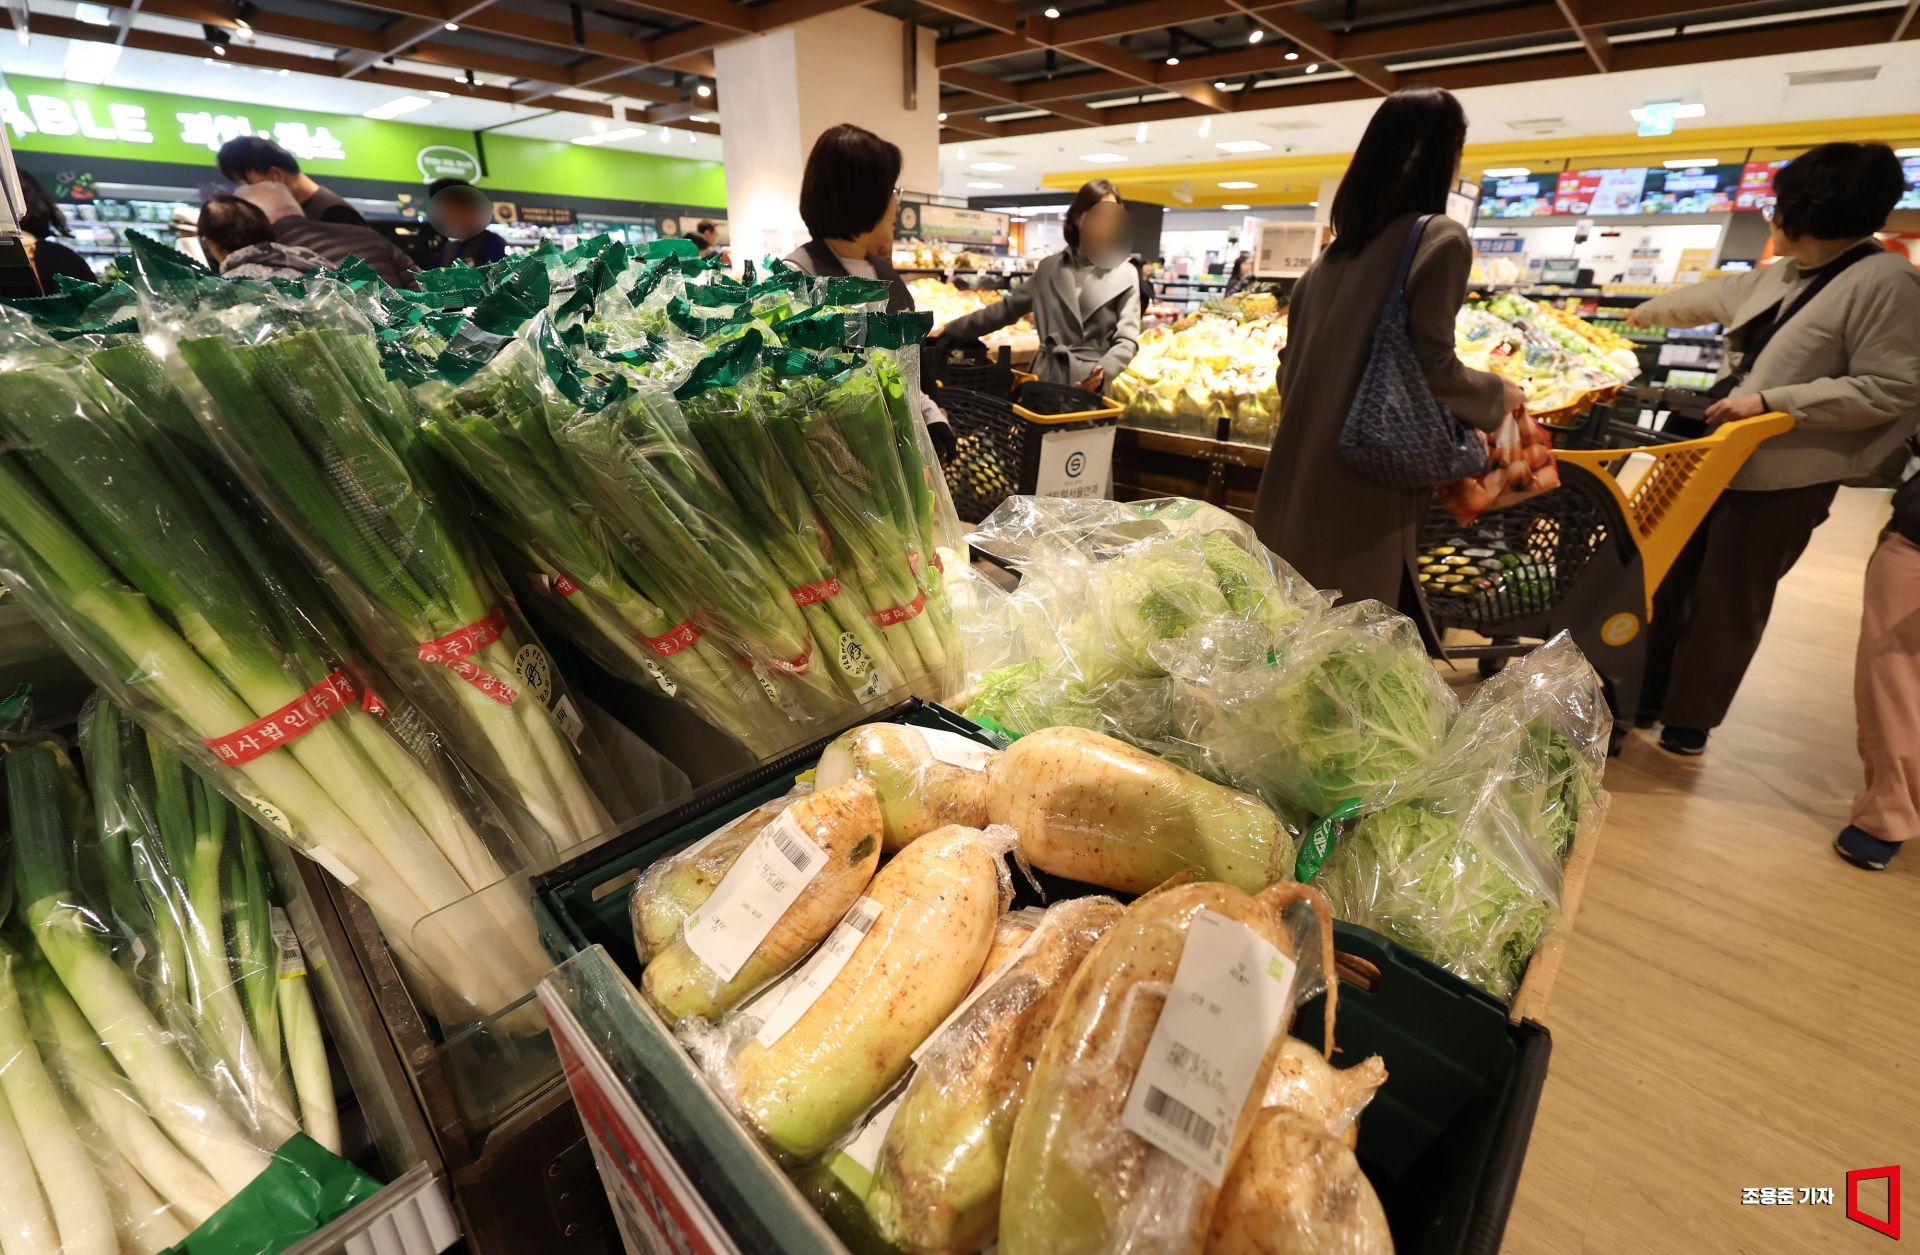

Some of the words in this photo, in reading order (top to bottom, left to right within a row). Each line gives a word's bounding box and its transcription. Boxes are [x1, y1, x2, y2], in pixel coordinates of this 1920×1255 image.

[516, 649, 530, 679] MER'S
[211, 676, 353, 761] 회사법인(주)정
[255, 802, 281, 822] ICK
